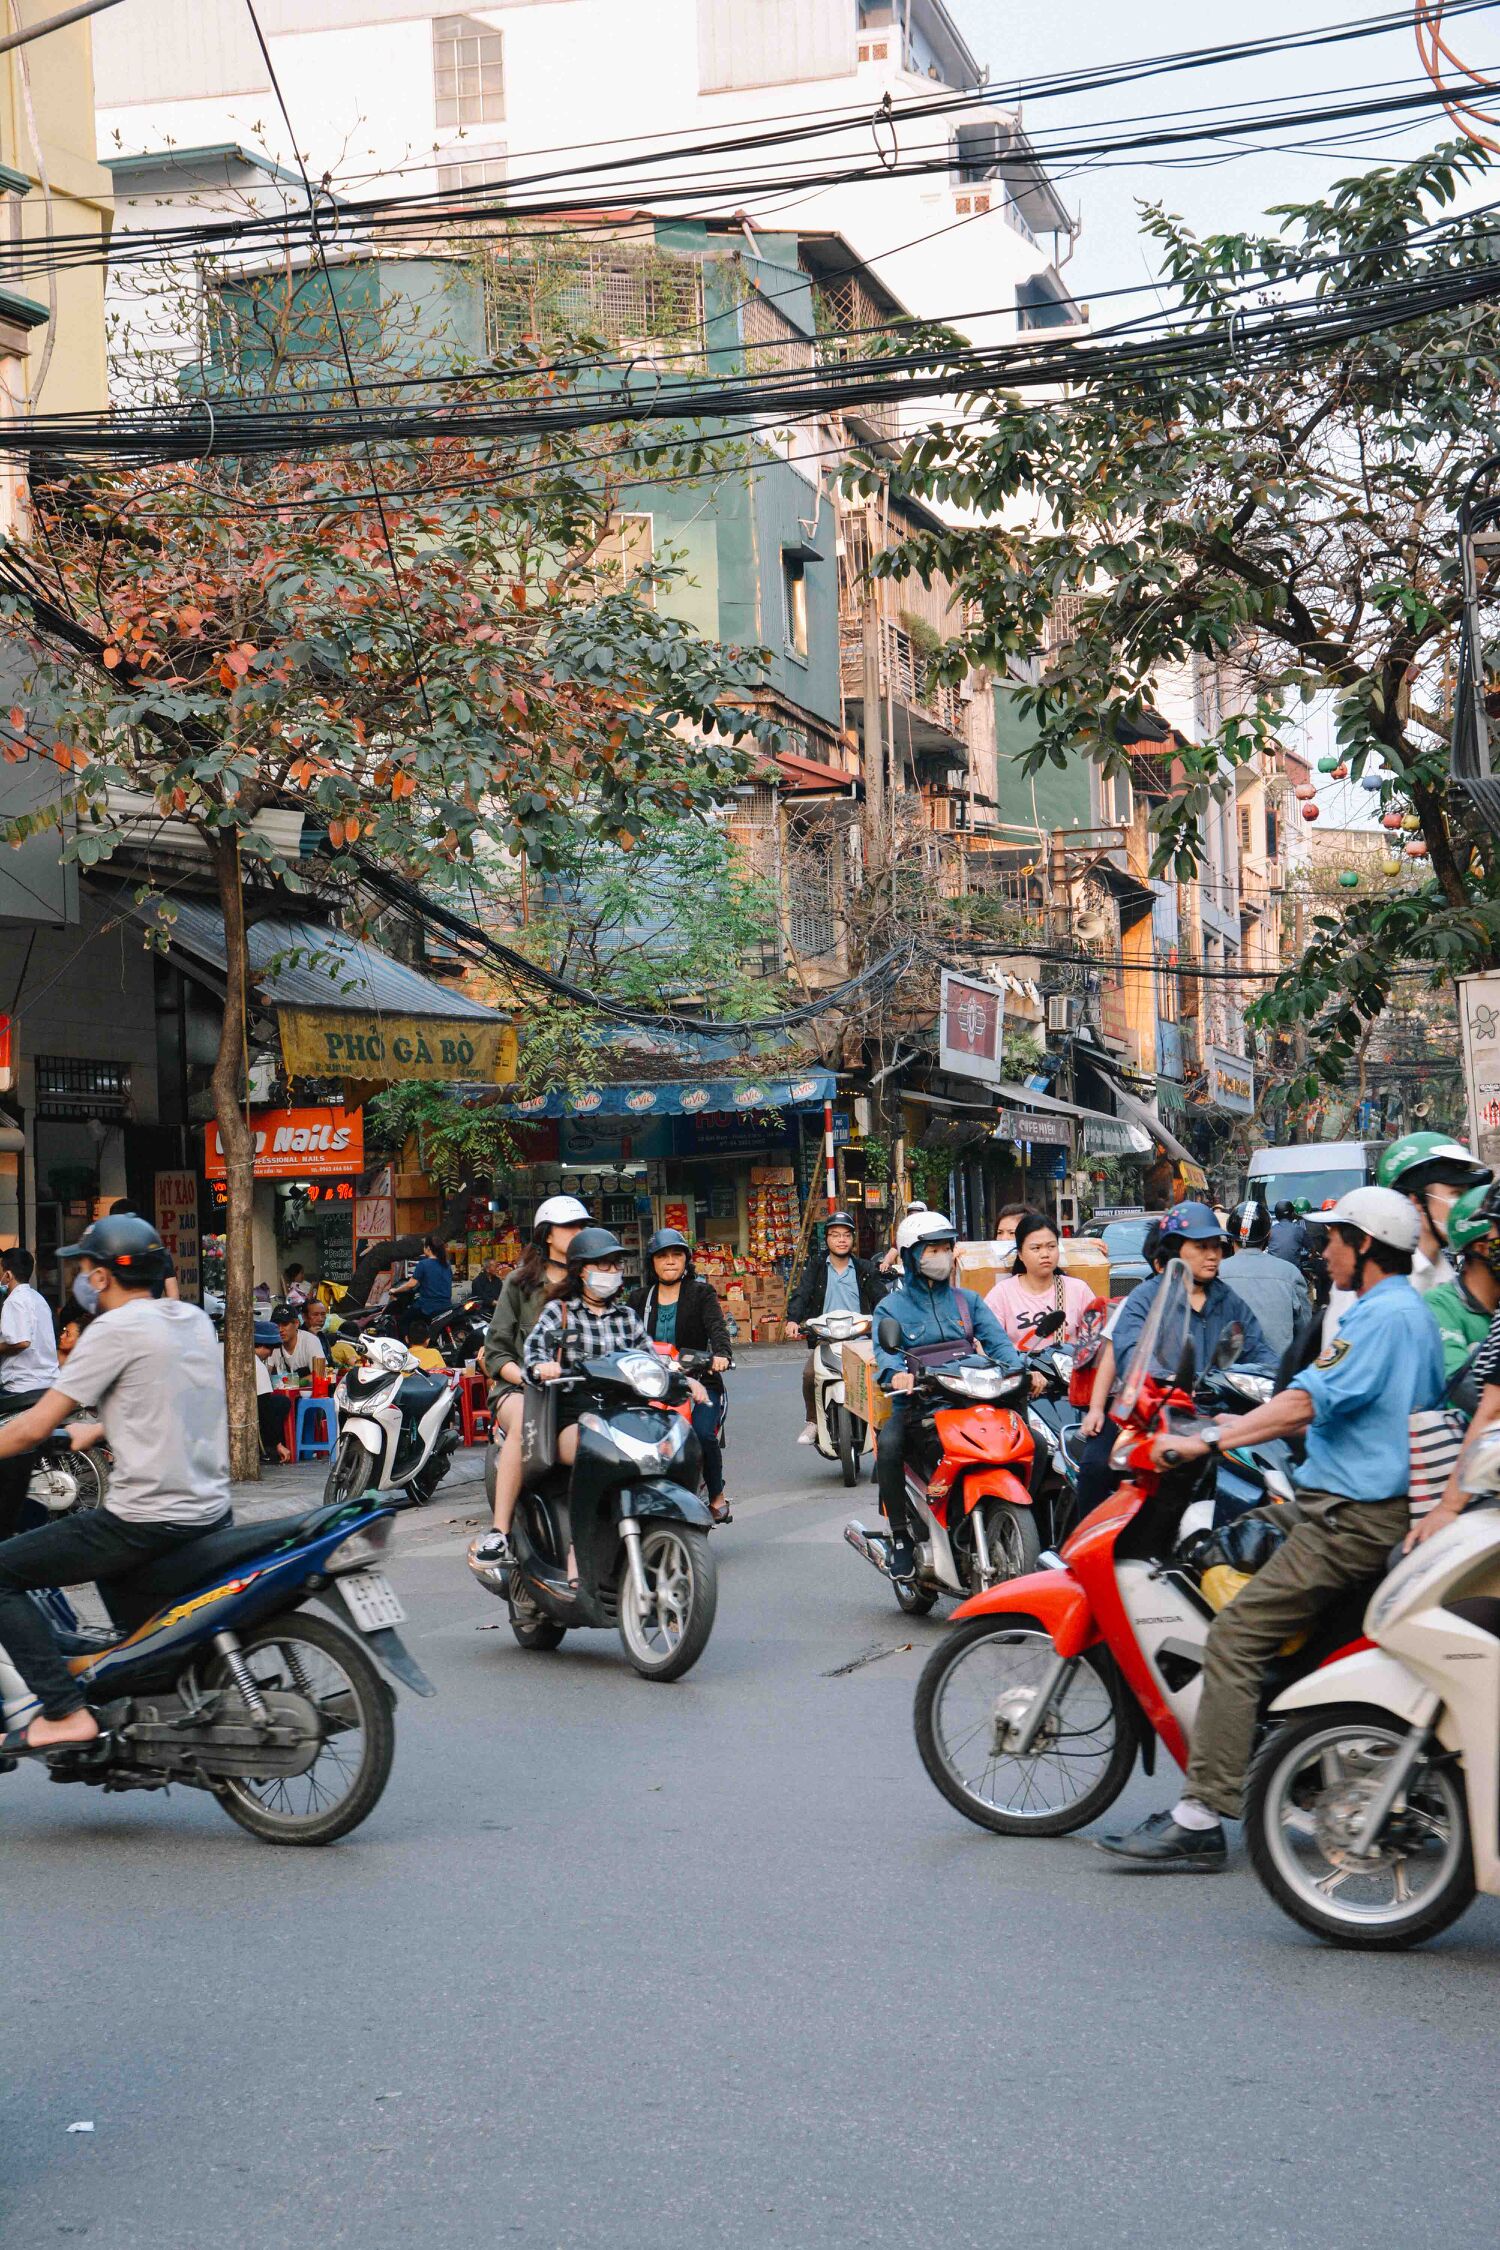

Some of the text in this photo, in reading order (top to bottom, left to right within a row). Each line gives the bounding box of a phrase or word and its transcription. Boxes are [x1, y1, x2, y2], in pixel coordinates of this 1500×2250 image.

[324, 1024, 474, 1065] PHỞ GÀ BÒ
[273, 1124, 352, 1153] Nails
[301, 1155, 326, 1163] NAILS
[1095, 1208, 1142, 1218] MONEY EXCHANGE
[1135, 1615, 1184, 1625] HONDA
[1442, 1652, 1489, 1661] HONDA
